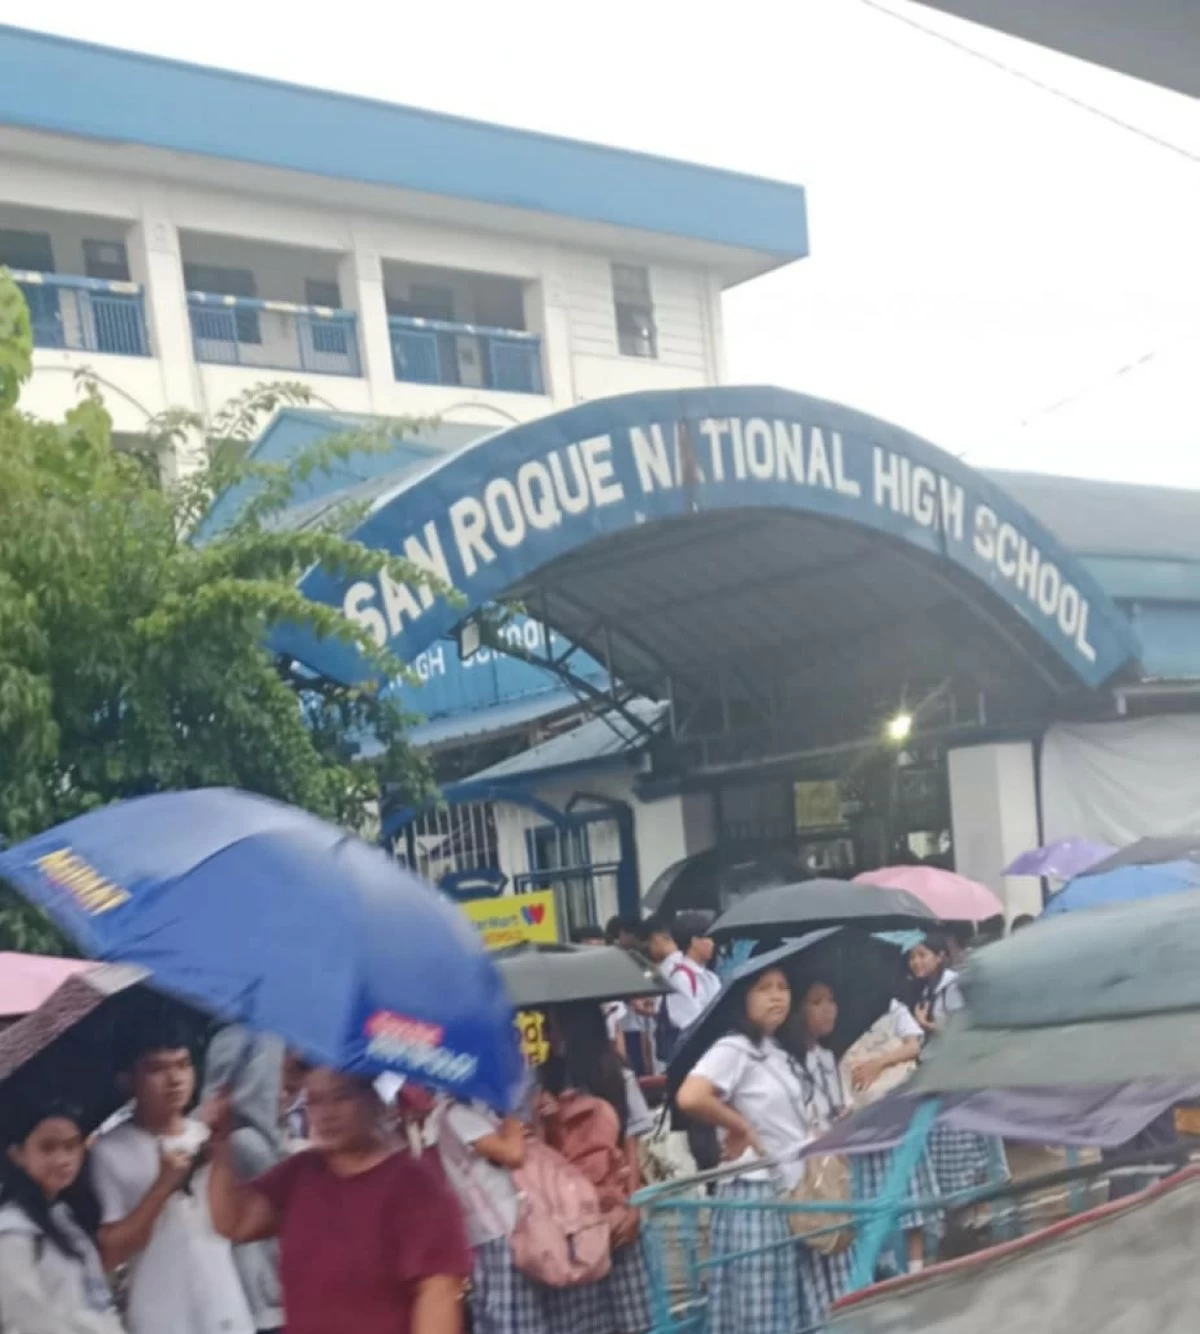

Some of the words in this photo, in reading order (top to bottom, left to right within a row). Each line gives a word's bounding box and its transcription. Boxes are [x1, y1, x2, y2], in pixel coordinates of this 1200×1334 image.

[343, 520, 454, 654] SAN
[449, 434, 624, 577] ROQUE
[873, 446, 964, 541] HIGH
[973, 504, 1097, 663] SCHOOL
